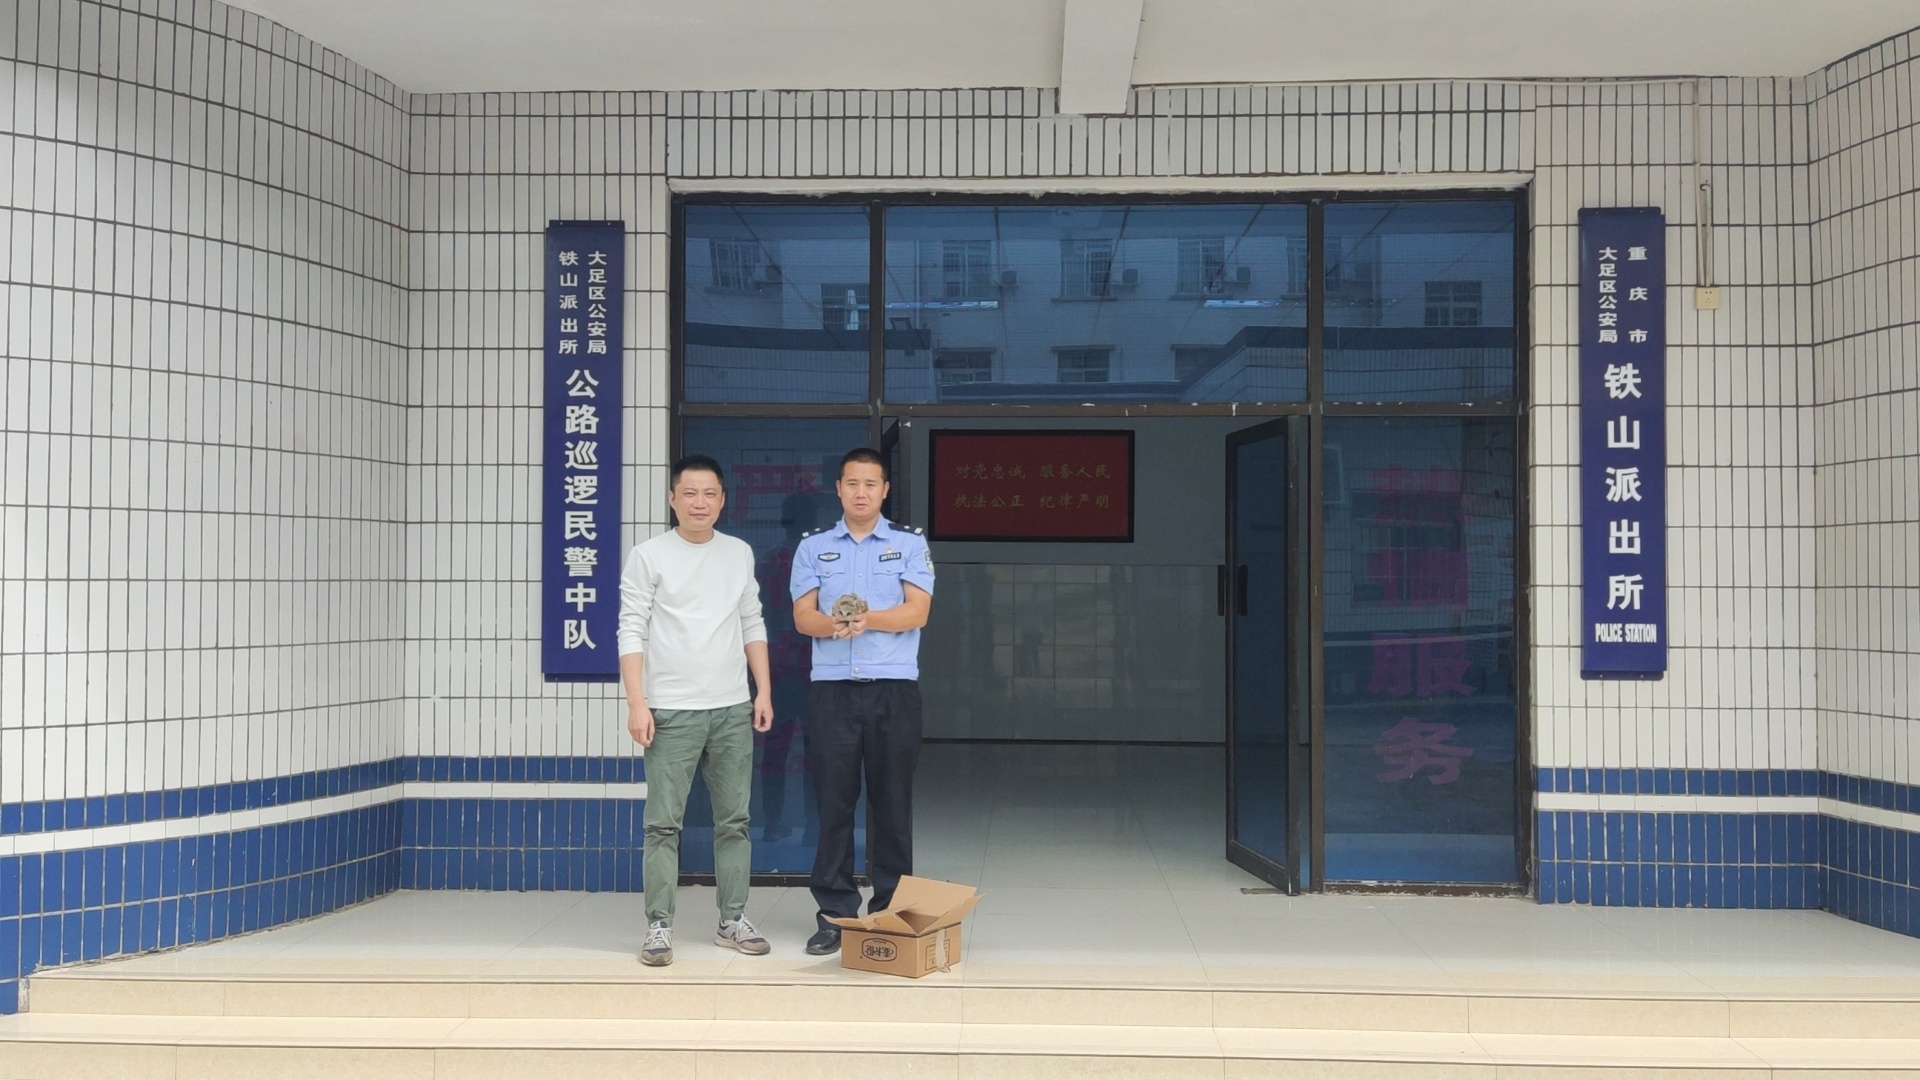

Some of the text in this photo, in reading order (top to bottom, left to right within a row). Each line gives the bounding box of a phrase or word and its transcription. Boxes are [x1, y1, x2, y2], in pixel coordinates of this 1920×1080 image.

[558, 250, 579, 355] 铁山派出所
[587, 250, 607, 355] 大足区公安局
[1598, 246, 1618, 344] 大足区公安局
[1627, 246, 1648, 343] 重庆市
[564, 369, 599, 650] 公路巡逻民警中队
[954, 492, 1109, 510] 执法公正 纪律严明
[955, 463, 1111, 480] 对党忠诚 服务人民
[1603, 362, 1643, 610] 铁山派出所
[1595, 623, 1657, 643] POLICE STATION
